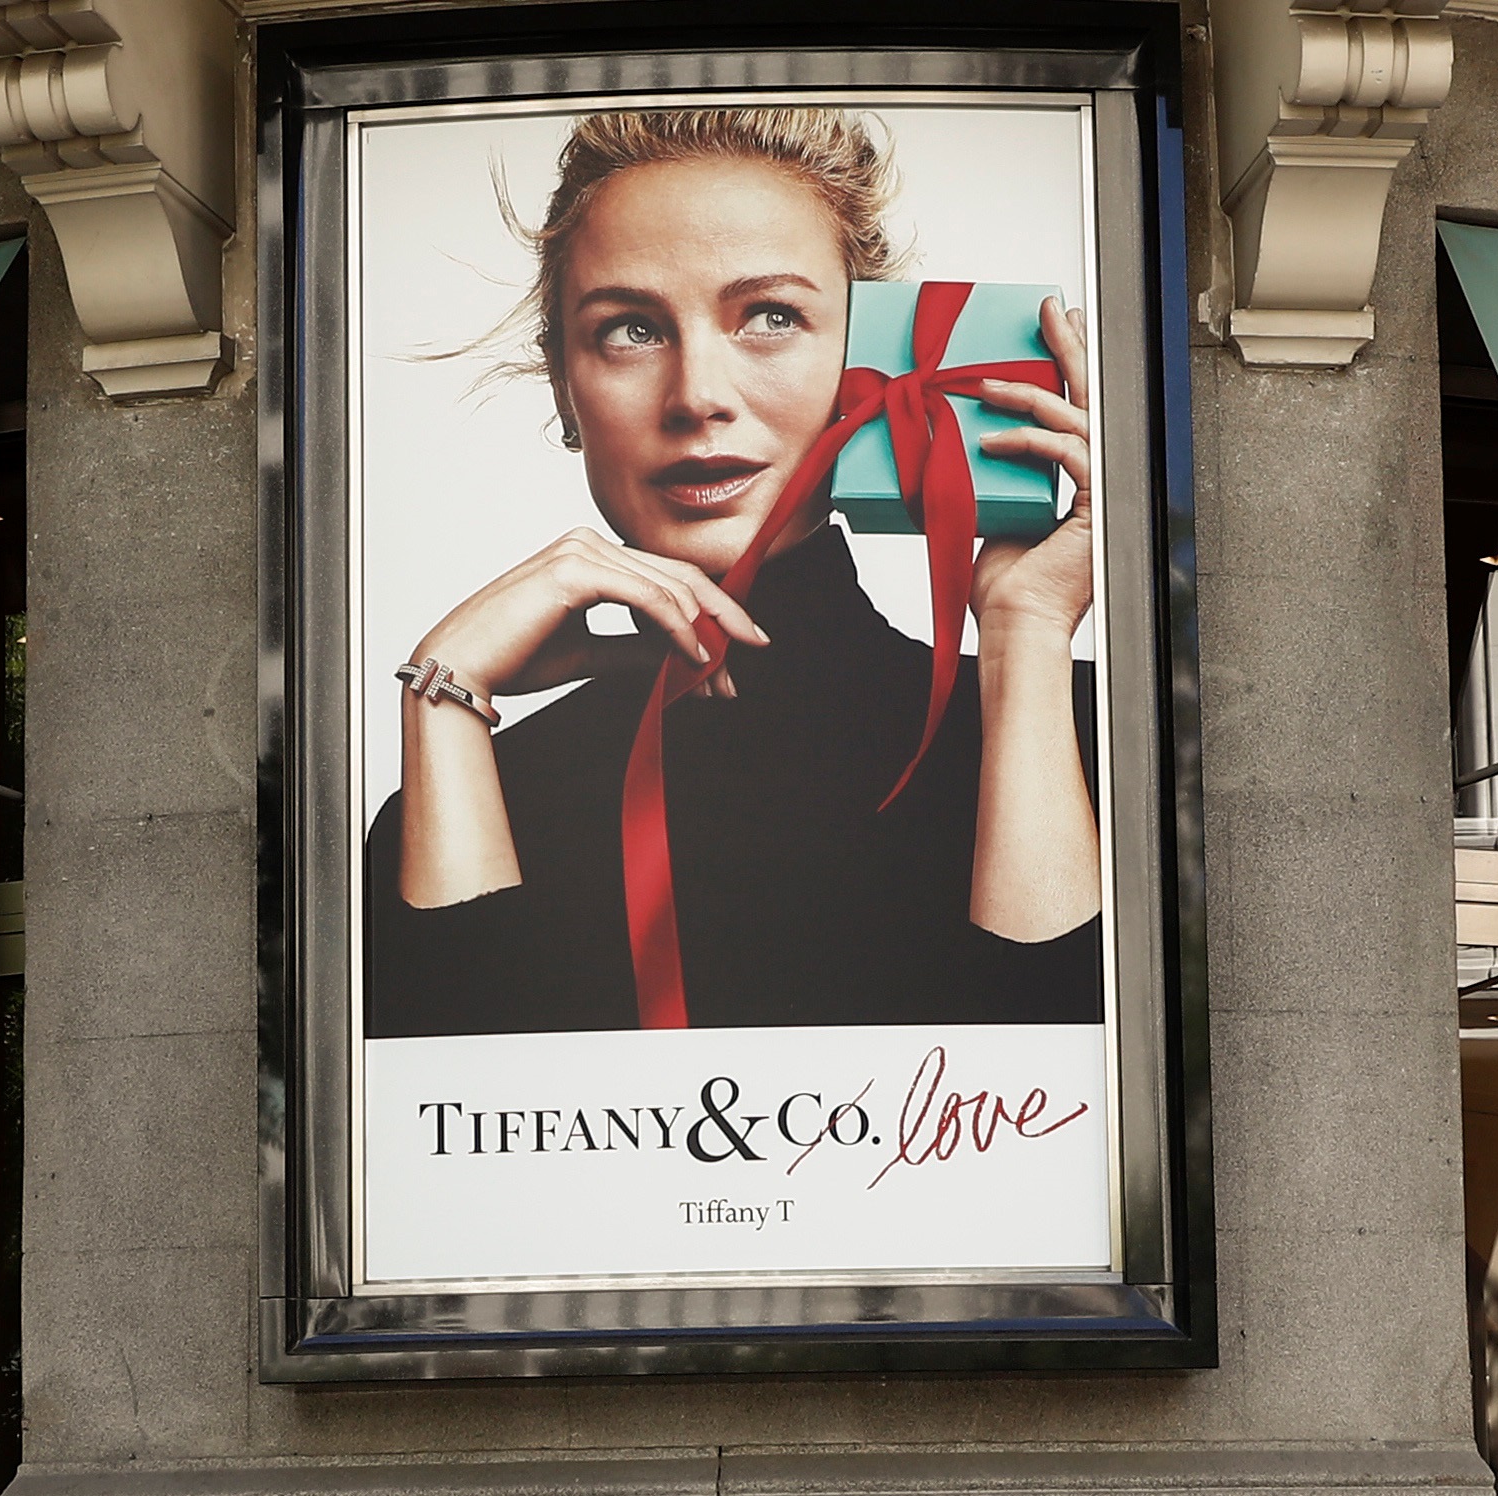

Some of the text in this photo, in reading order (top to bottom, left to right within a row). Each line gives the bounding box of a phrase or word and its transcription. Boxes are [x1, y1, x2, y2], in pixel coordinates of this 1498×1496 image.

[867, 1045, 1089, 1190] love
[679, 1198, 795, 1231] Tiffany T
